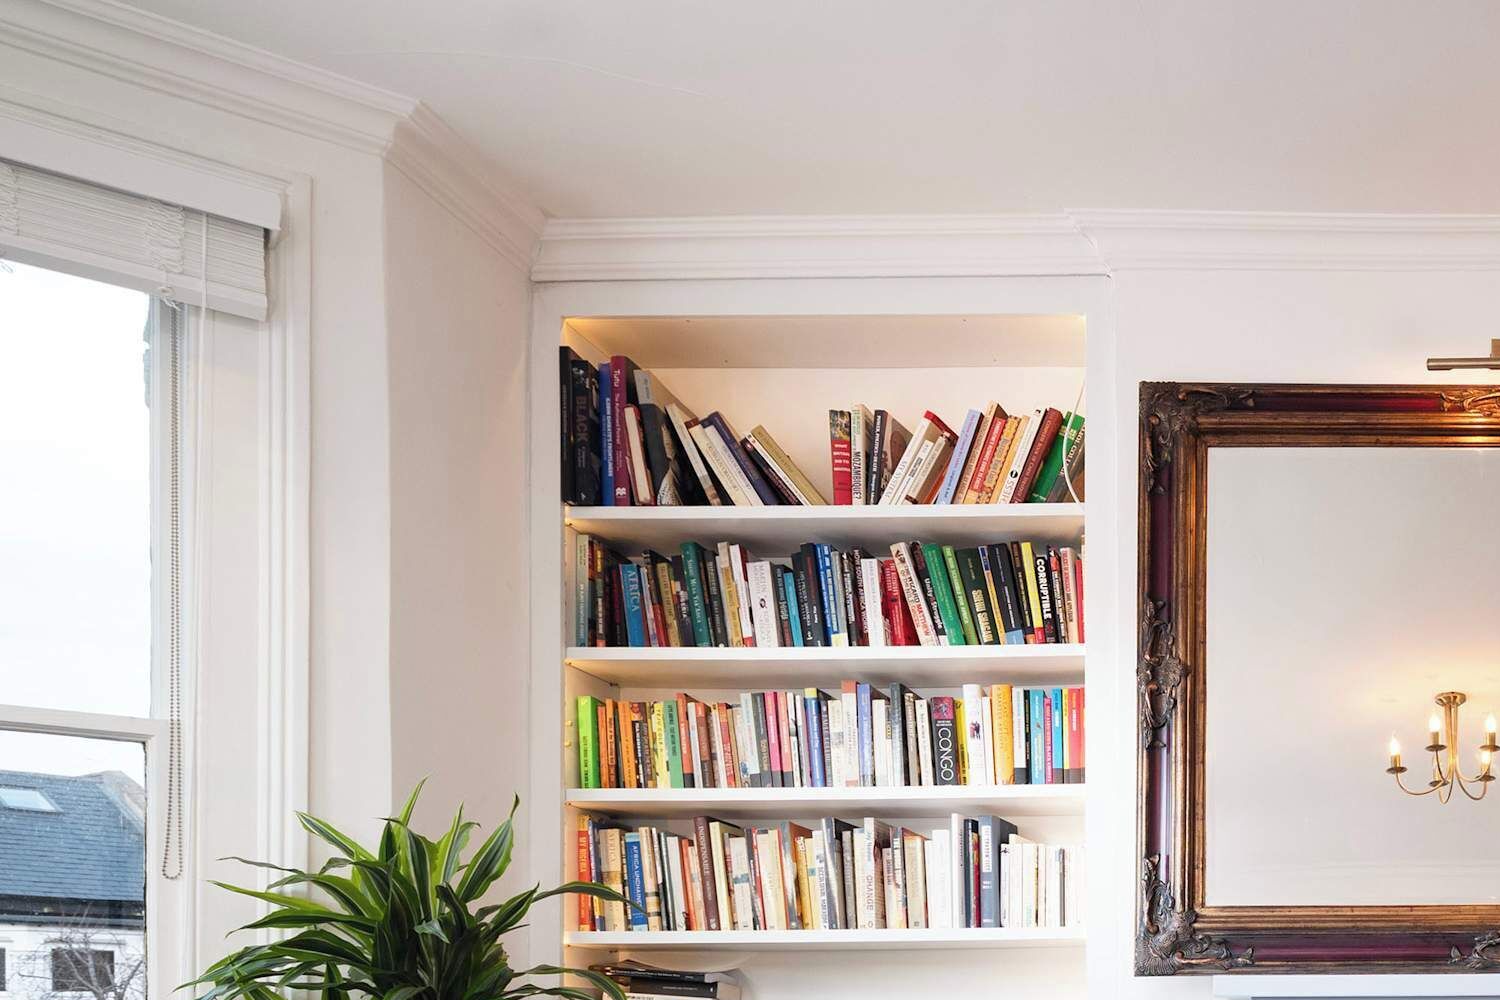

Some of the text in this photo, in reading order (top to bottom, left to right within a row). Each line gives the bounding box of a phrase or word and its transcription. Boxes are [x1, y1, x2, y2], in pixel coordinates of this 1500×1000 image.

[613, 369, 621, 387] Tutu
[575, 396, 588, 443] BLACK
[852, 451, 862, 499] MOZAMBIQUE?
[885, 471, 903, 498] SYSTEM
[853, 549, 861, 566] HOW
[856, 566, 864, 588] SOUTH
[908, 576, 920, 603] WIZARD
[1037, 558, 1052, 619] CORRUPTIBLE
[627, 570, 641, 612] AFRICA
[858, 588, 866, 611] AFRICA
[924, 578, 943, 630] Unity Struggle
[959, 607, 969, 625] AFRICA
[937, 727, 954, 781] CONGO
[580, 837, 588, 848] MY
[698, 825, 710, 876] INDISPENSABLE
[632, 845, 640, 870] AFRICA
[866, 875, 874, 911] CHANGE
